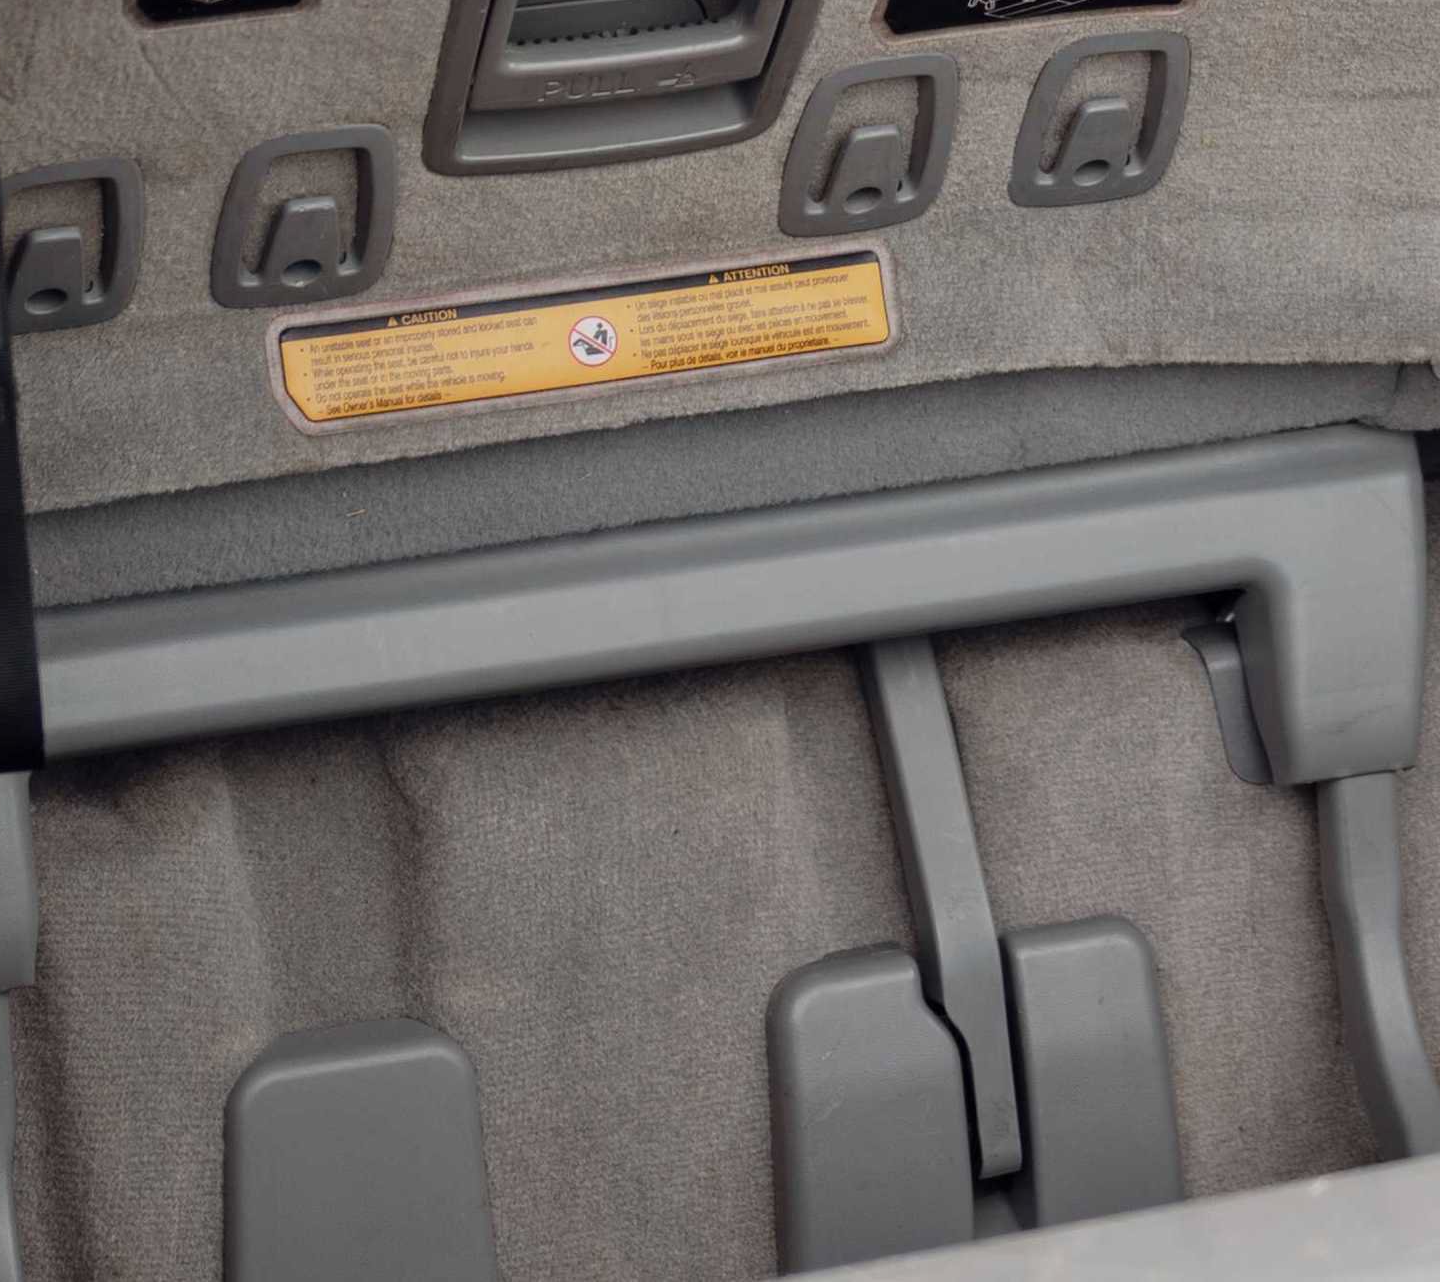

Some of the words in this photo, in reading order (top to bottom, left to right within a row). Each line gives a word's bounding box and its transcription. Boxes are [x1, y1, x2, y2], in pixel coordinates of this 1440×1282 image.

[537, 71, 637, 102] PULL
[723, 264, 789, 280] ATTENTION
[402, 309, 457, 324] CAUTION
